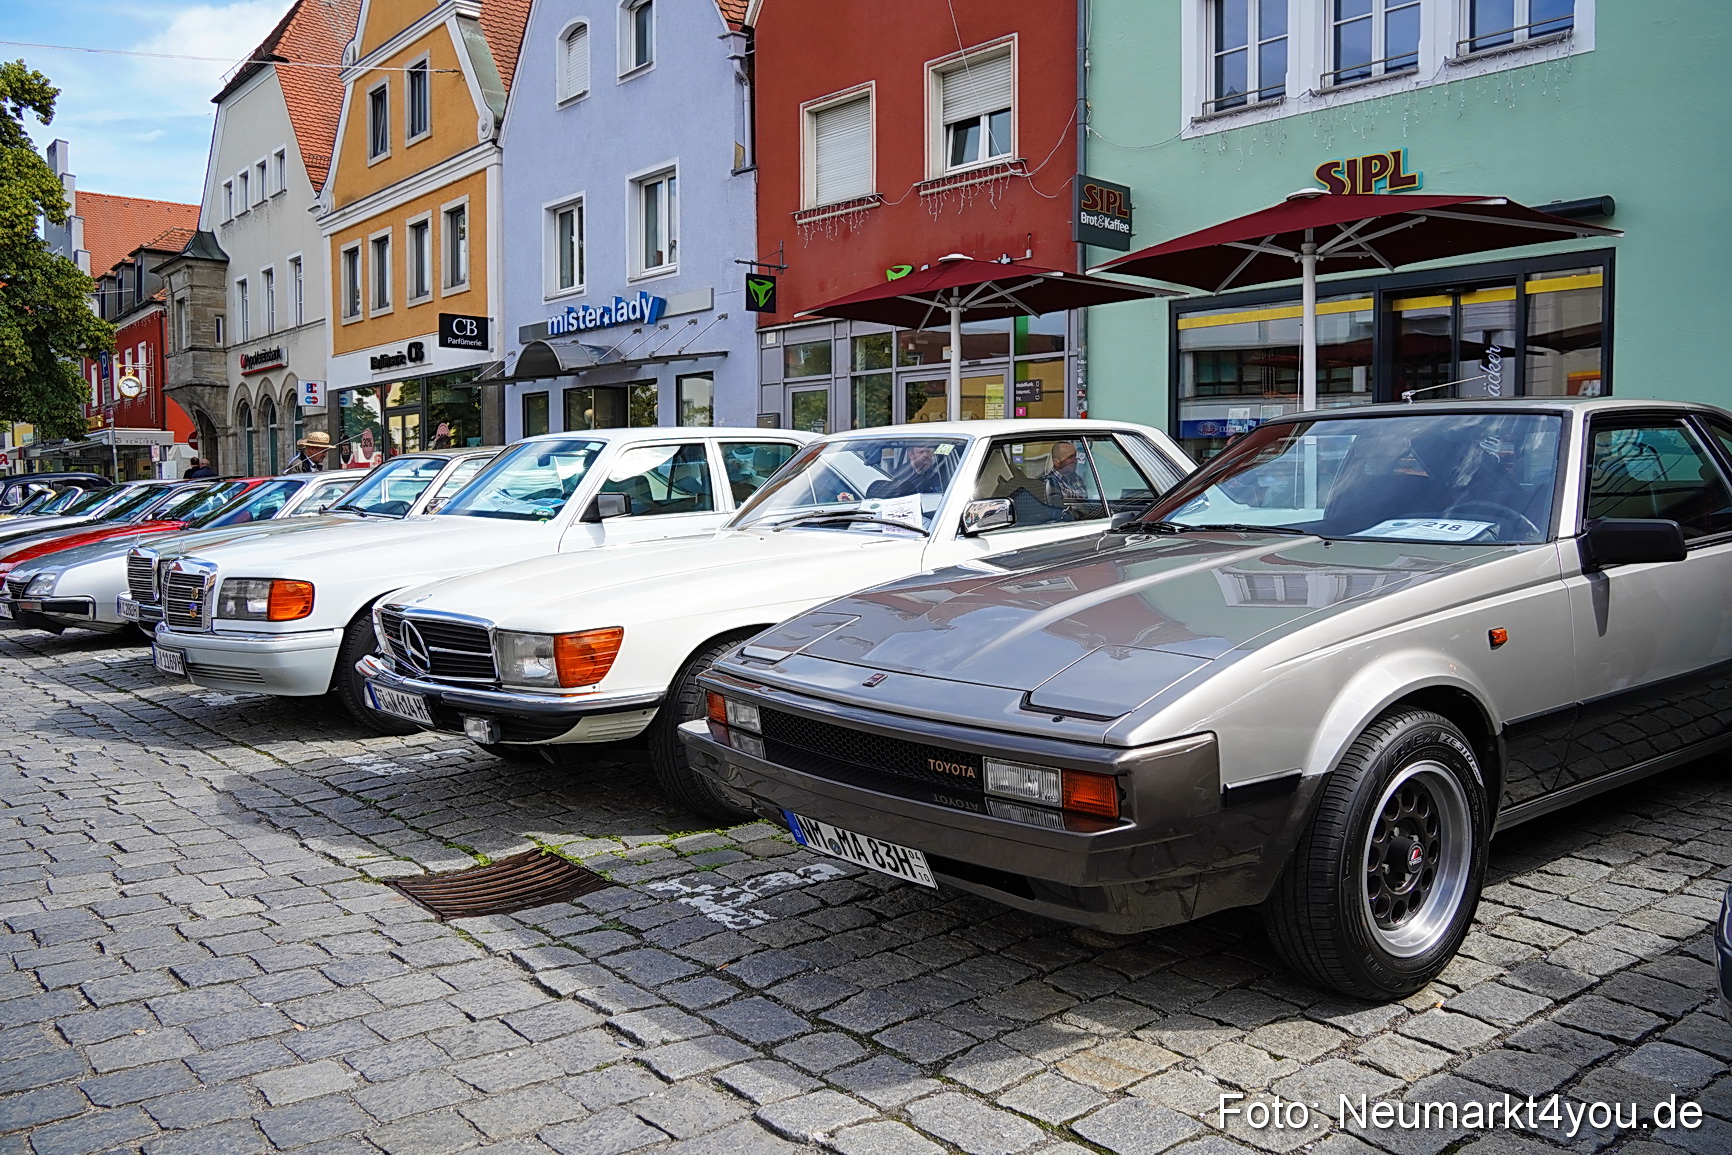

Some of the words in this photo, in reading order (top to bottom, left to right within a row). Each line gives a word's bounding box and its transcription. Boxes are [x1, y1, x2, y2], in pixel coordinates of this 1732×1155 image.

[1314, 148, 1421, 195] SIPL
[1081, 183, 1129, 218] SIPL
[1080, 211, 1130, 233] Brot&Kaffee
[547, 304, 605, 335] mister
[611, 290, 659, 325] lady
[452, 318, 478, 336] CB
[447, 336, 483, 347] Parfümerie
[1480, 344, 1502, 397] äcker
[1422, 521, 1463, 532] 218
[927, 758, 976, 779] TOYOTA
[795, 814, 830, 850] NM
[833, 827, 871, 864] MA
[866, 837, 918, 879] 83H
